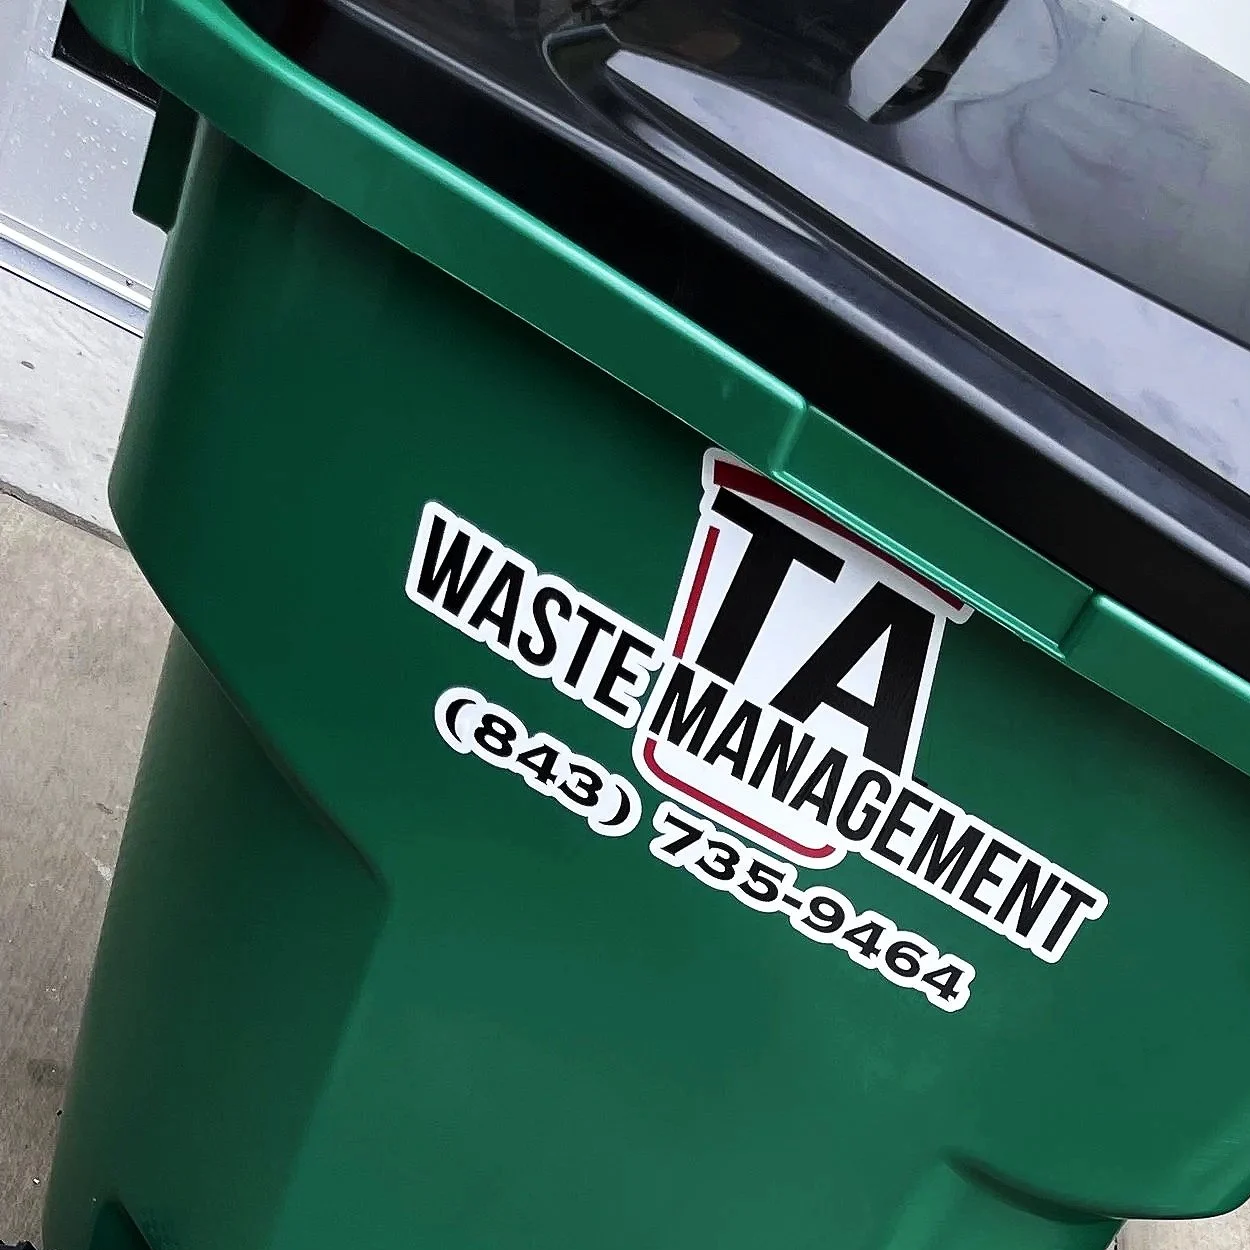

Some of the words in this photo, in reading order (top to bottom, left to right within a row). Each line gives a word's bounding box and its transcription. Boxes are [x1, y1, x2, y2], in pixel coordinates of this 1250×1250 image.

[416, 513, 655, 718] WASTE
[652, 667, 1097, 952] MANAGEMENT
[696, 487, 936, 777] TA
[445, 697, 632, 826] (843)
[657, 811, 965, 1003] 735-9464
